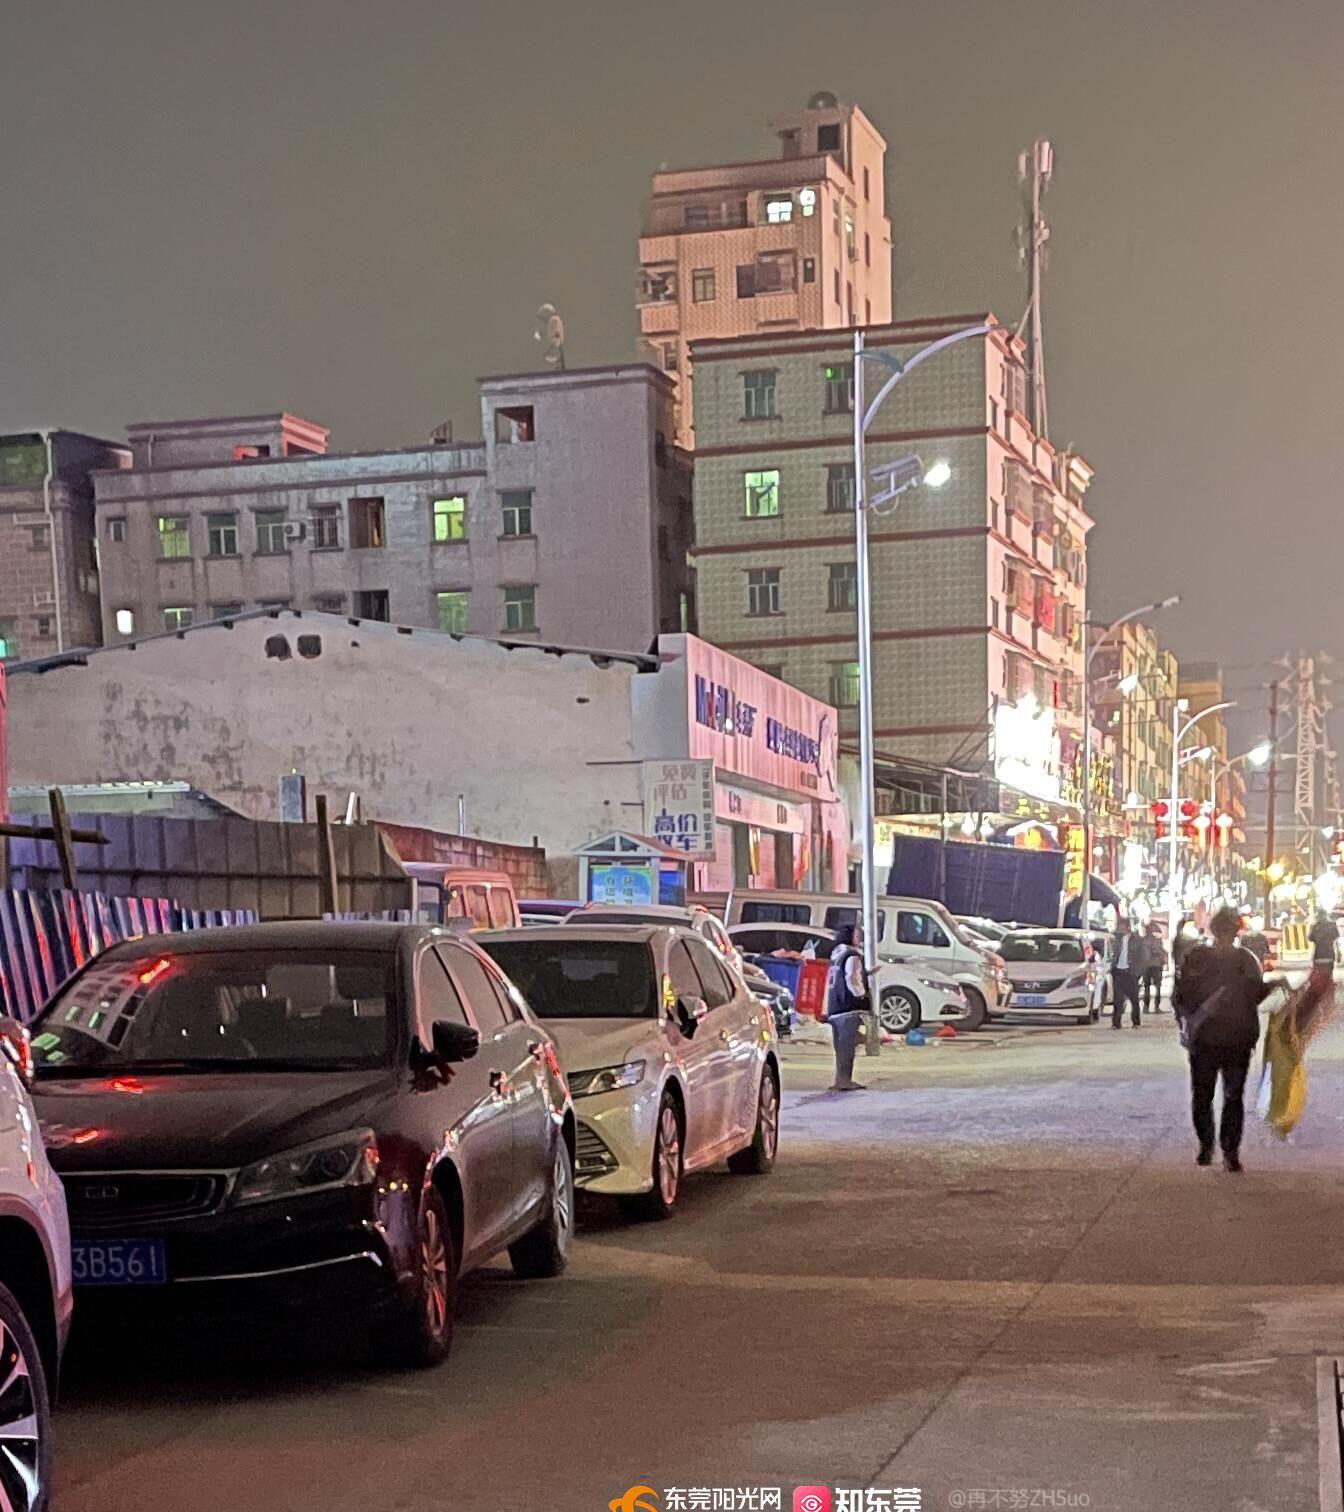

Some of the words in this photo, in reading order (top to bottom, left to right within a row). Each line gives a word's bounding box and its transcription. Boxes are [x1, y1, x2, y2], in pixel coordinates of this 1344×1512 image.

[662, 764, 697, 782] 免费
[654, 783, 687, 804] 评估
[654, 808, 698, 833] 高价
[72, 1245, 157, 1278] 3B561
